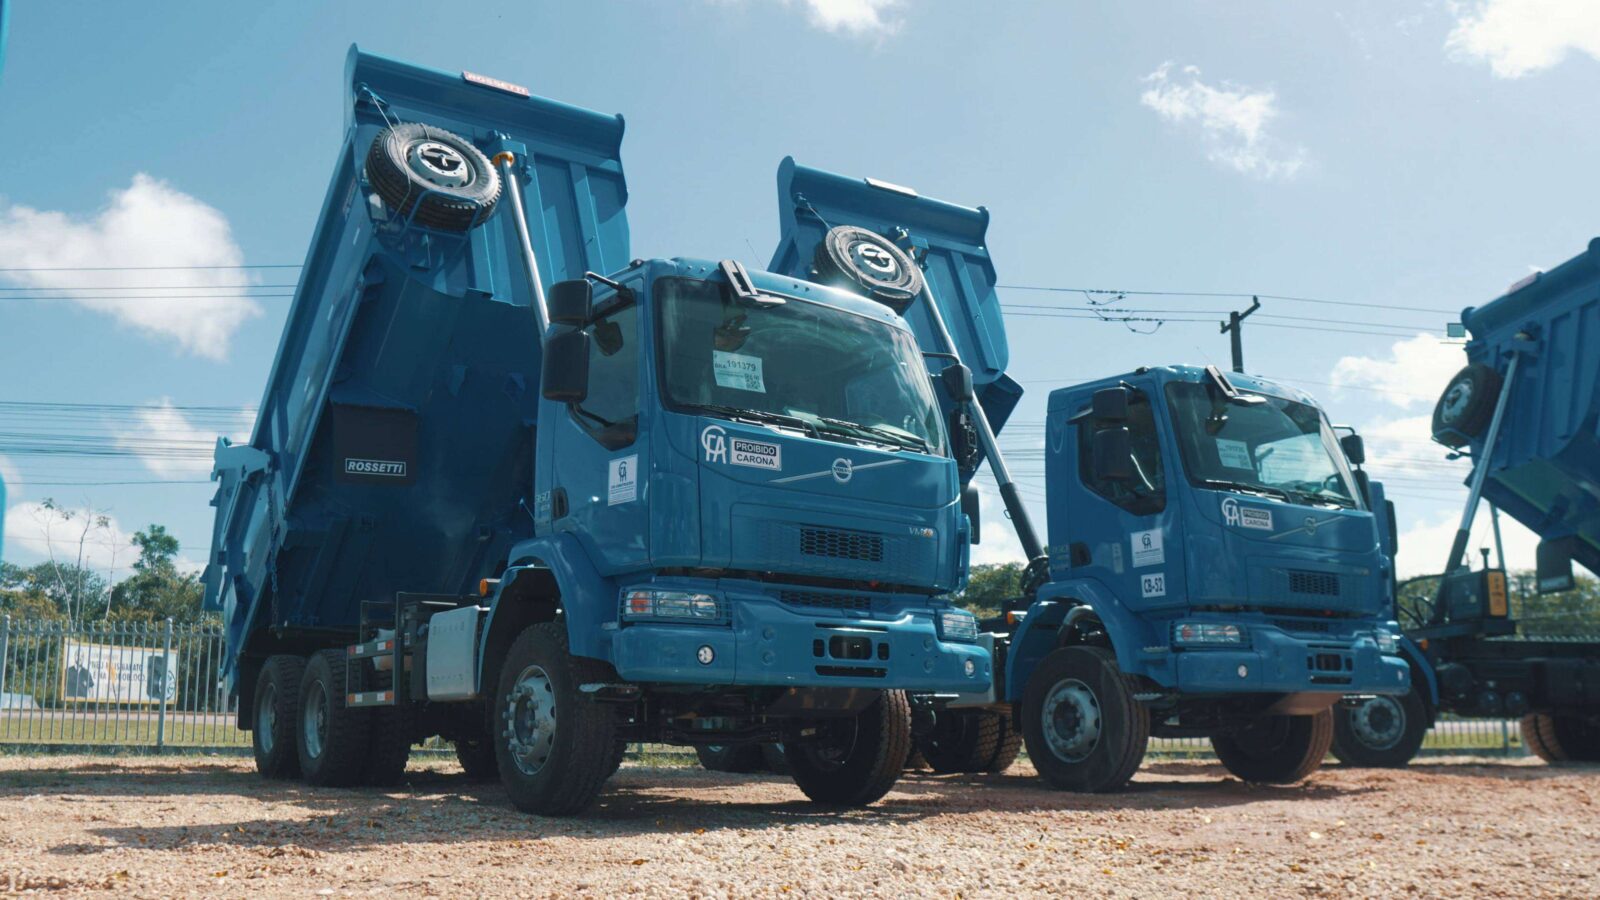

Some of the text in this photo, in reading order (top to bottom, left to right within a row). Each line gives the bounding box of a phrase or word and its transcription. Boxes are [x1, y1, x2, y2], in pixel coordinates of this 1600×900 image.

[736, 442, 775, 455] PROIBIDO
[736, 454, 775, 466] CARONA
[348, 461, 403, 473] ROSSETTI
[1144, 577, 1163, 593] CB-52
